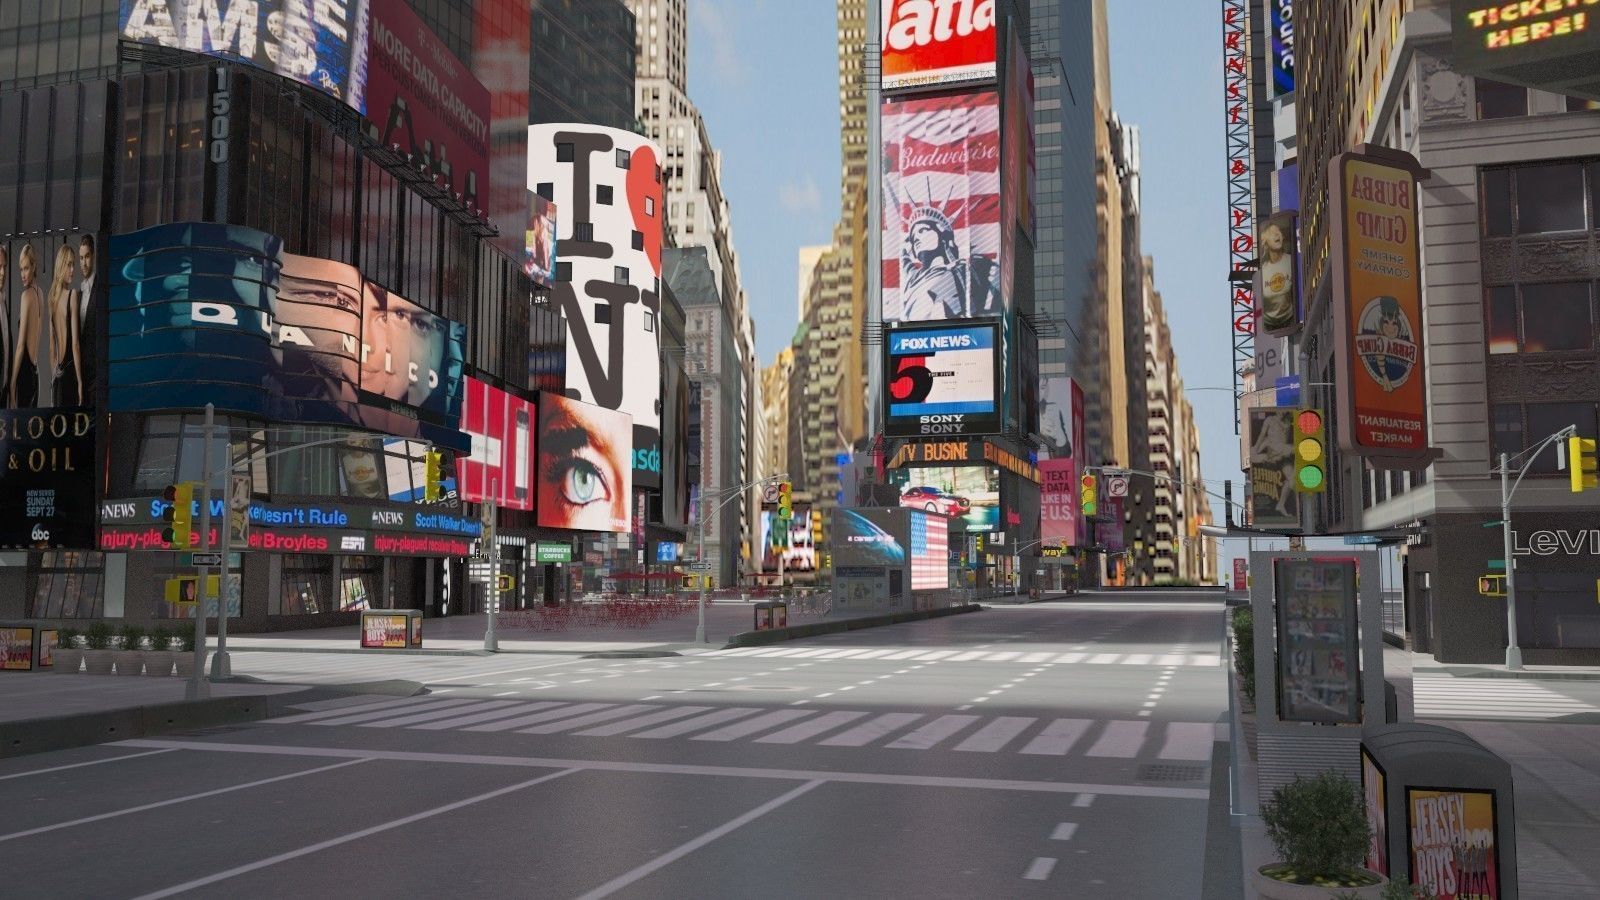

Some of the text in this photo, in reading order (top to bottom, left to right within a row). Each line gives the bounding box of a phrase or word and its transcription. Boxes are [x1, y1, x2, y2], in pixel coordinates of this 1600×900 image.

[1486, 12, 1585, 48] HERE!
[373, 16, 488, 143] MORE DATA CAPACITY
[211, 66, 230, 163] 1500
[901, 335, 971, 350] FOX NEWS
[920, 415, 964, 424] SONY
[8, 447, 75, 472] & OIL
[902, 444, 916, 462] TV
[1046, 470, 1069, 481] TEXT
[1047, 482, 1070, 493] DATA
[26, 497, 55, 507] SUNDAY
[1041, 493, 1071, 503] LIKE IN
[26, 506, 55, 517] SEPT 27
[309, 509, 348, 525] Rule
[1050, 505, 1073, 520] U.S.
[415, 512, 437, 529] Scott
[438, 514, 460, 531] Walker
[32, 529, 50, 541] abc
[264, 532, 328, 551] Broyles
[341, 536, 365, 551] ESPN
[366, 617, 393, 630] JERSEY
[366, 629, 386, 642] BOYS
[1412, 793, 1465, 847] JERSEY
[1416, 847, 1456, 897] BOYS
